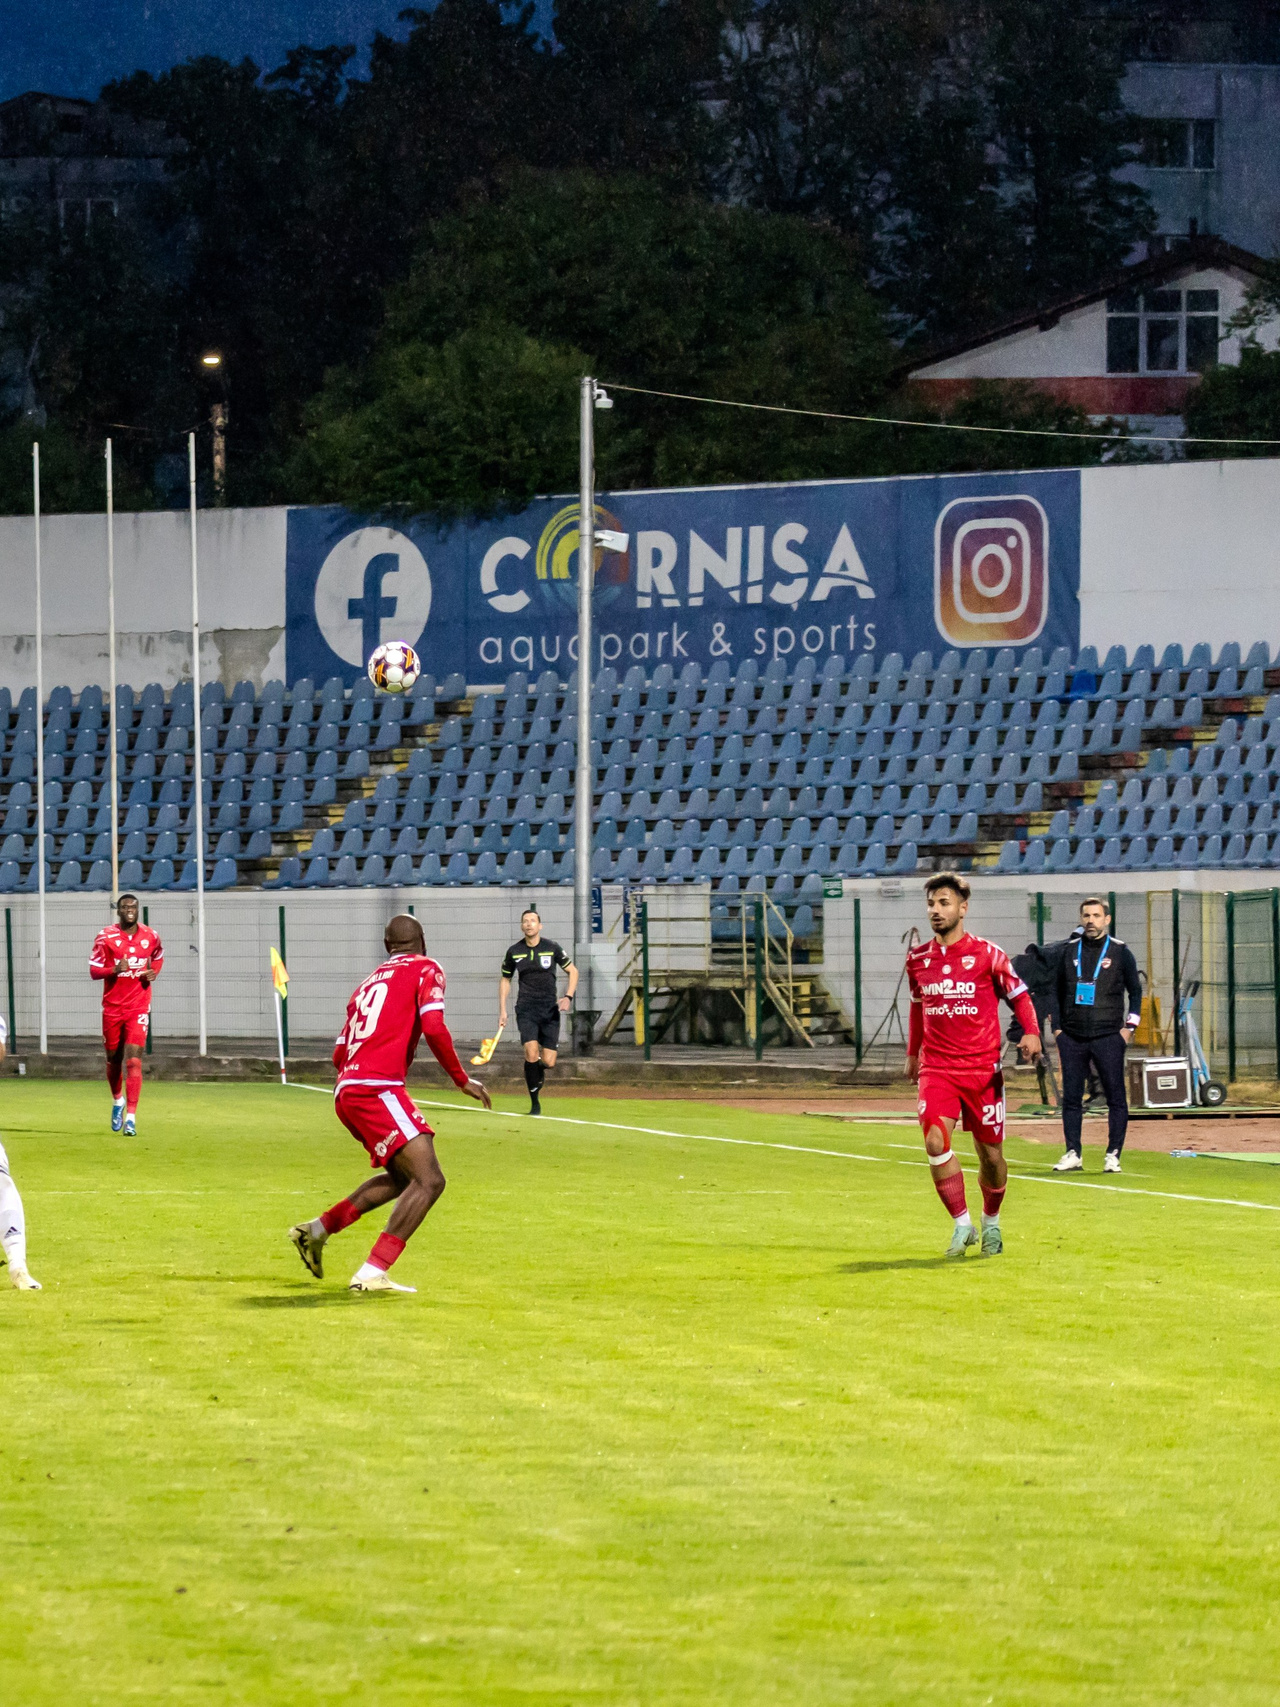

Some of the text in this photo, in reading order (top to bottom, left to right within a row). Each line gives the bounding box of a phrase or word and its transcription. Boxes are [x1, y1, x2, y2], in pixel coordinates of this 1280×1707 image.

[708, 621, 734, 657] &
[754, 614, 877, 662] sports
[982, 1101, 1003, 1125] 20
